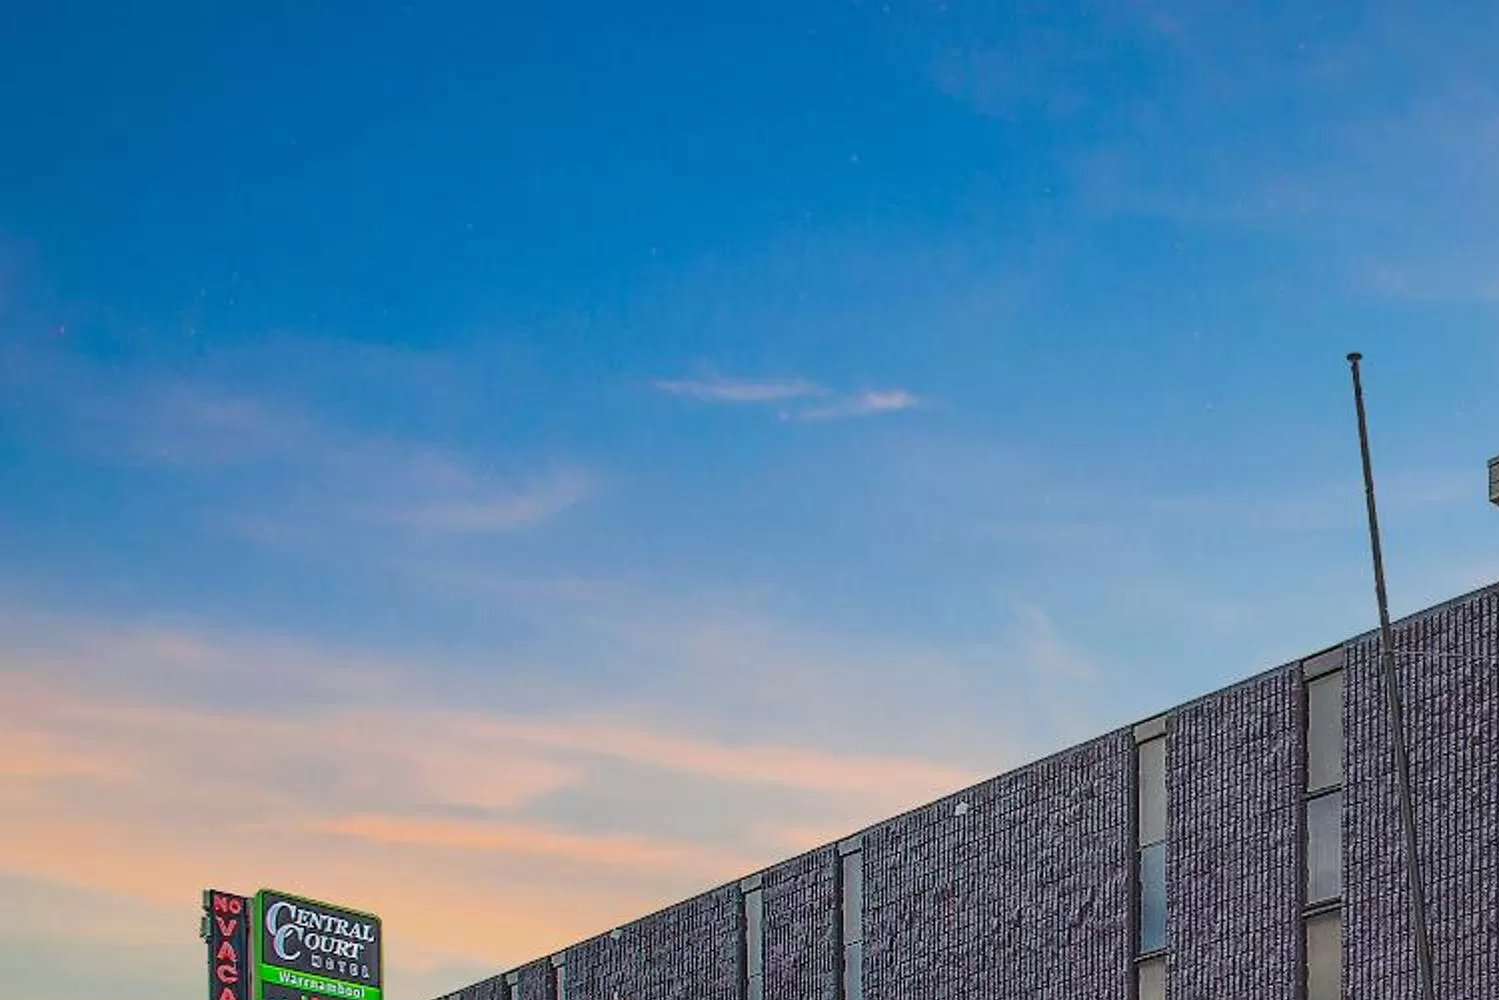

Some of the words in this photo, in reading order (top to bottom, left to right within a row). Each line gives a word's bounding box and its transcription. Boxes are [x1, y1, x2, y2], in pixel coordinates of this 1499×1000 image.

[213, 895, 242, 915] NO
[265, 901, 376, 943] CENTRAL
[274, 923, 365, 961] COURT
[311, 954, 370, 979] MOTEL
[279, 971, 366, 999] Warrnambool
